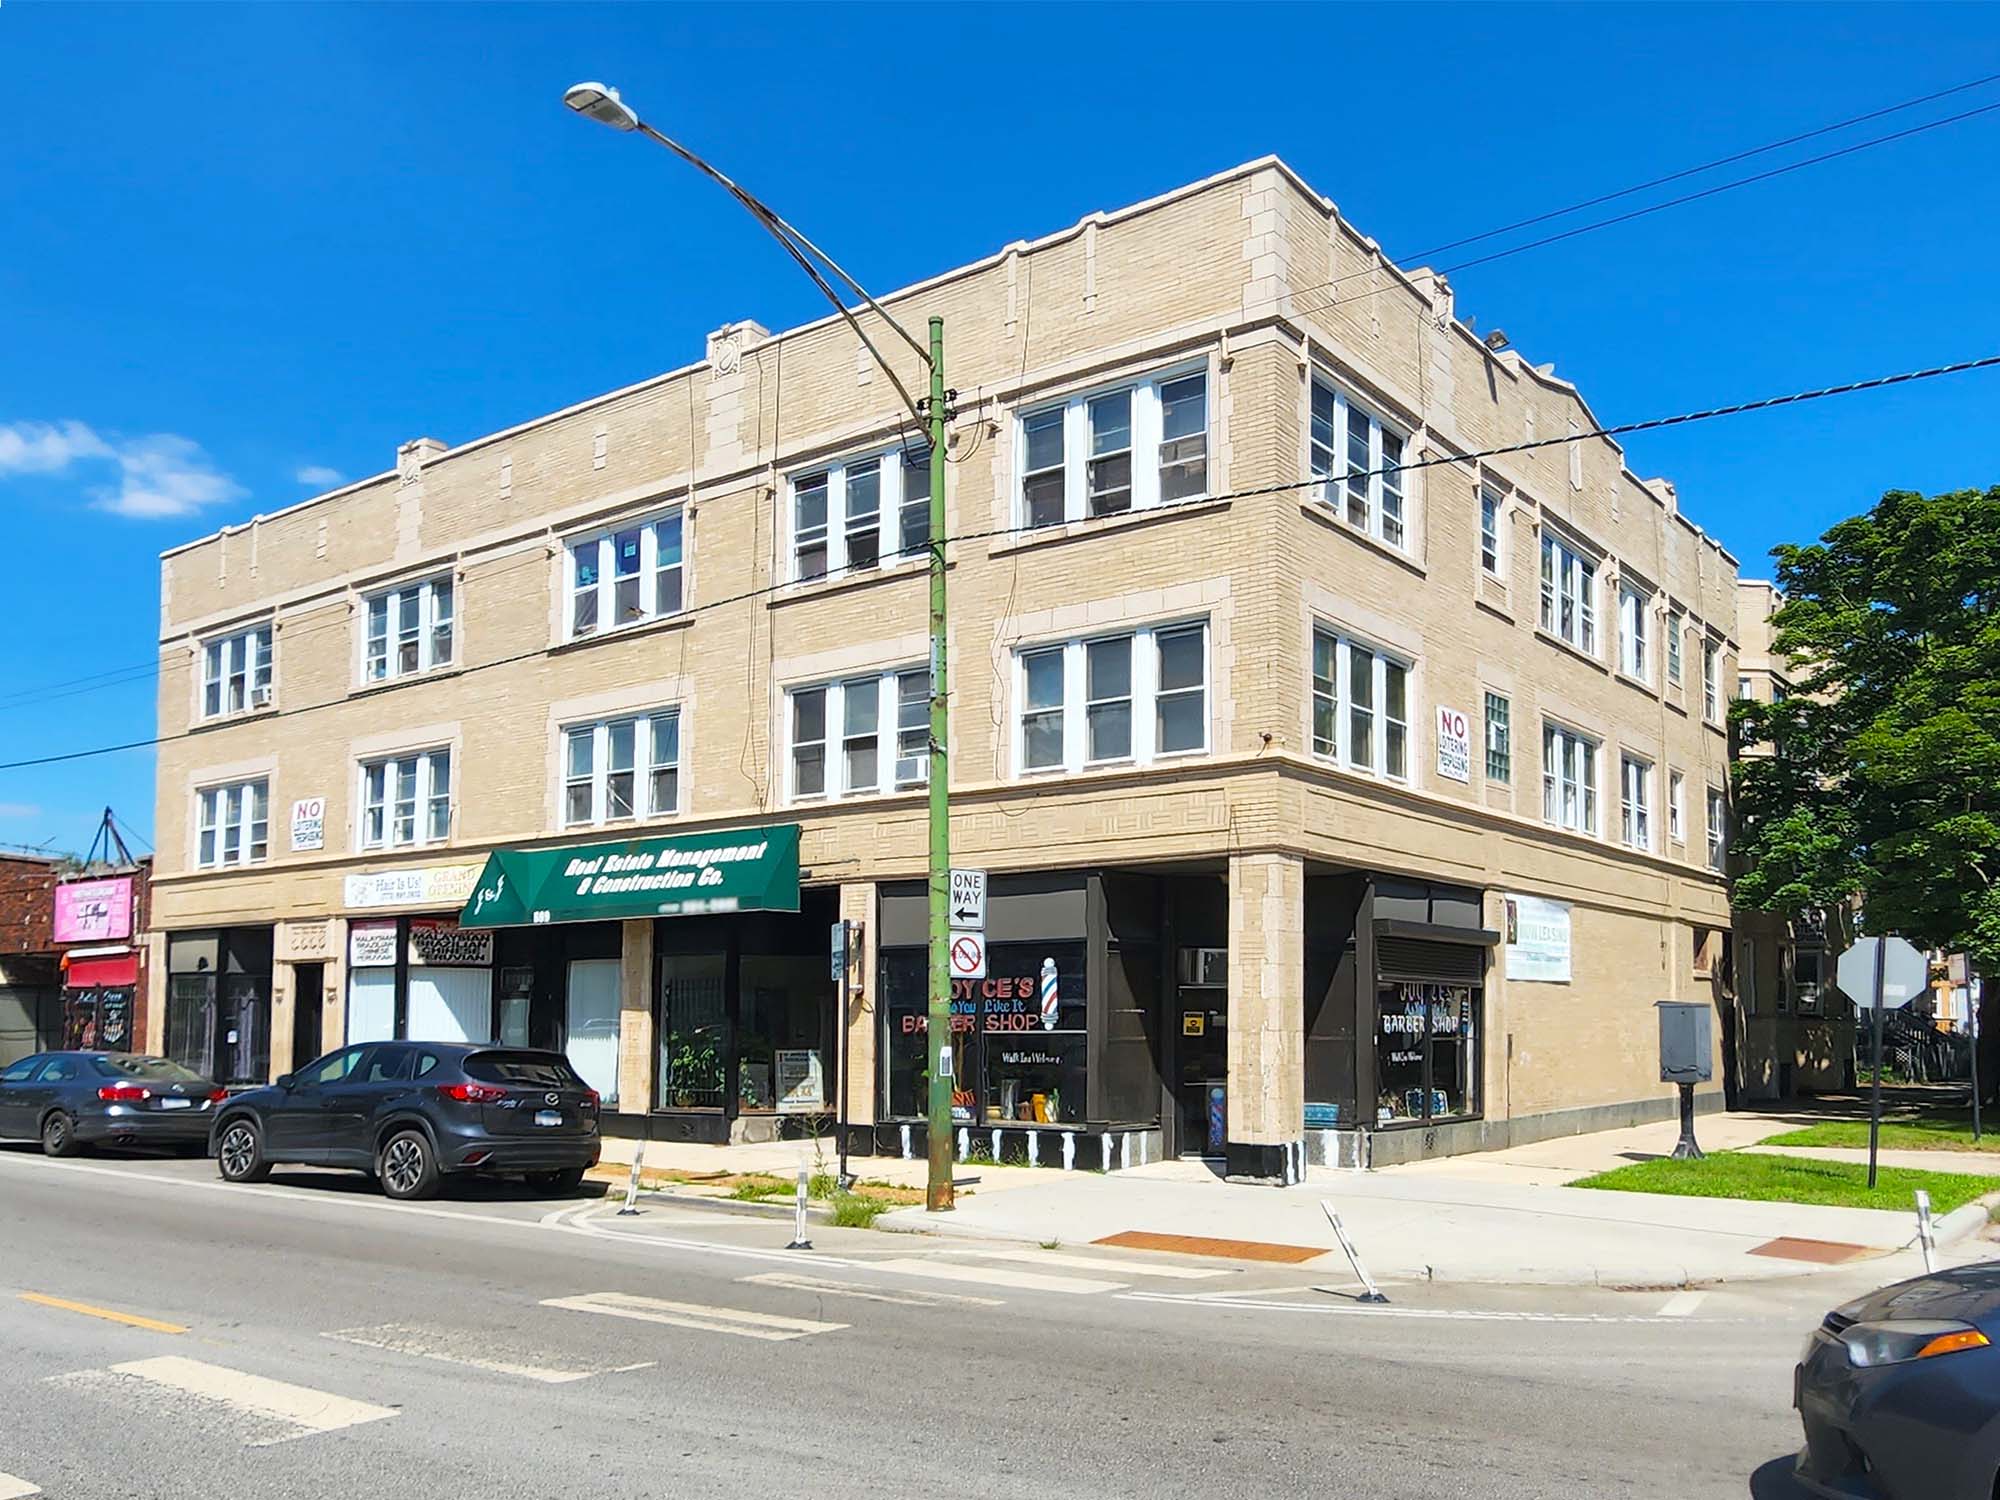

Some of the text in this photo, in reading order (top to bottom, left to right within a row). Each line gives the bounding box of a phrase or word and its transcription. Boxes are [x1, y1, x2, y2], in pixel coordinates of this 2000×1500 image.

[1442, 709, 1465, 738] NO
[297, 801, 320, 819] NO
[564, 841, 768, 876] Real Estate Management
[592, 870, 696, 894] Construction
[697, 866, 724, 887] Co.
[954, 873, 981, 889] ONE
[953, 890, 981, 904] WAY
[983, 999, 1011, 1013] Like
[1012, 999, 1026, 1013] It
[986, 1014, 1039, 1031] SHOP
[1383, 1015, 1459, 1034] BARBER SHOP
